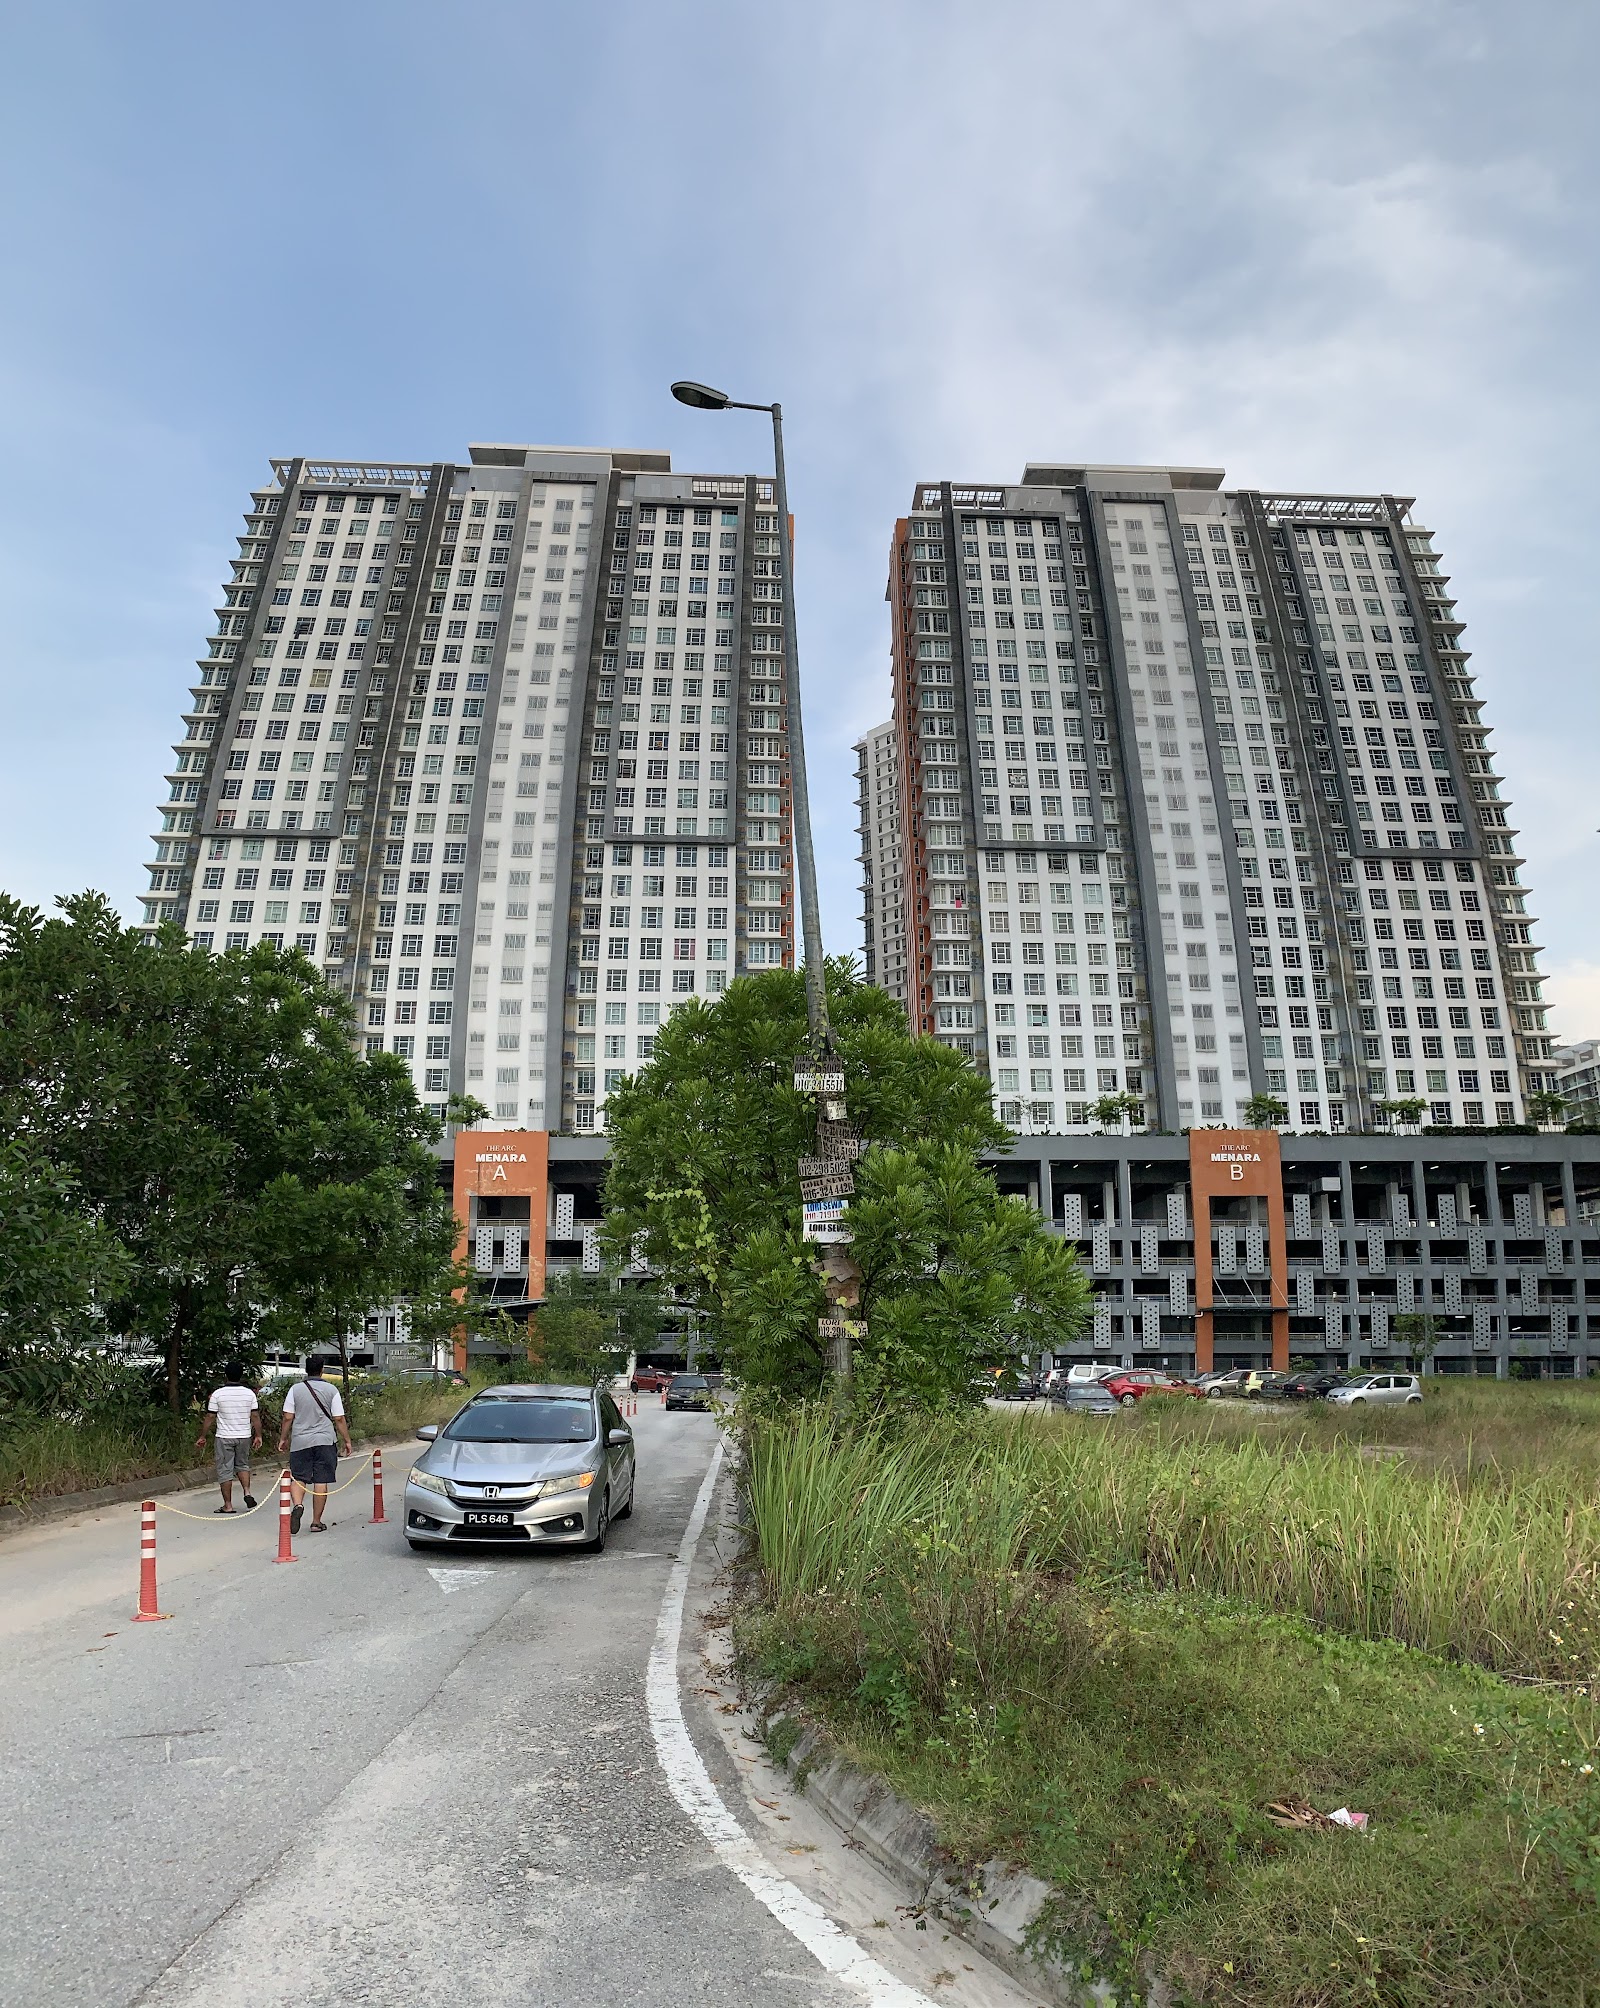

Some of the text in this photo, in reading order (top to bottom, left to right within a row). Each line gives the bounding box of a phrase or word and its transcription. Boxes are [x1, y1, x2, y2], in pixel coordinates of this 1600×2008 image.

[475, 1154, 527, 1162] MENARA
[826, 1154, 846, 1162] SEWA
[1210, 1153, 1261, 1161] MENARA
[492, 1165, 507, 1181] A
[1230, 1164, 1244, 1180] B
[802, 1176, 851, 1189] LORI SEWA
[806, 1200, 843, 1212] LORI SEWA
[469, 1514, 509, 1524] PLS 646
